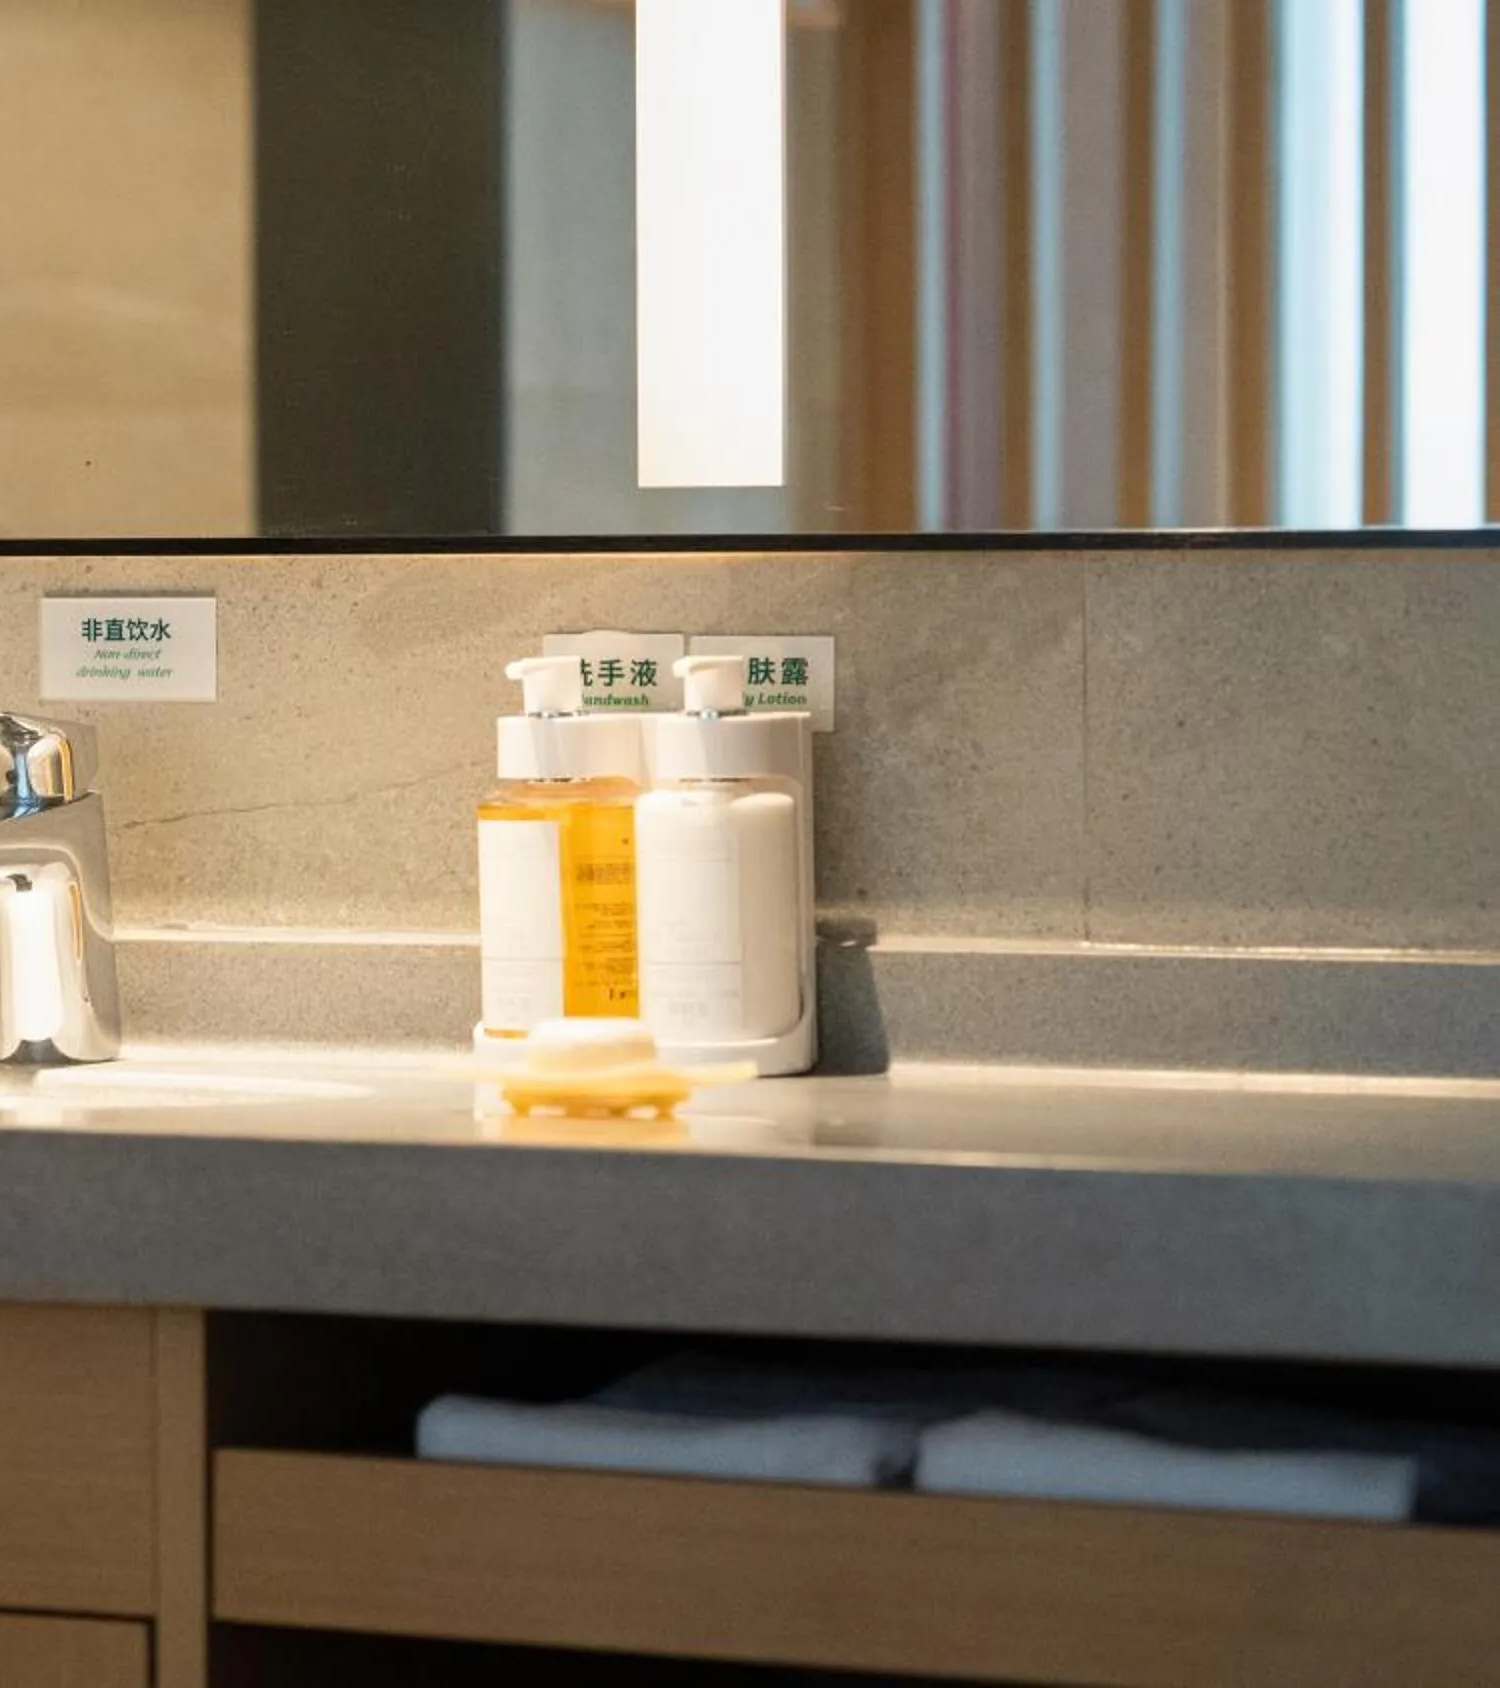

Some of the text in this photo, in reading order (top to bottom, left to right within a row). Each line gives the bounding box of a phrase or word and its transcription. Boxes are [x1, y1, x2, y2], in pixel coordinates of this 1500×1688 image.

[81, 617, 172, 642] 非直饮水
[75, 664, 173, 680] drinking water
[746, 656, 809, 686] 肤露
[582, 693, 649, 706] andwash
[757, 692, 807, 705] Lotion
